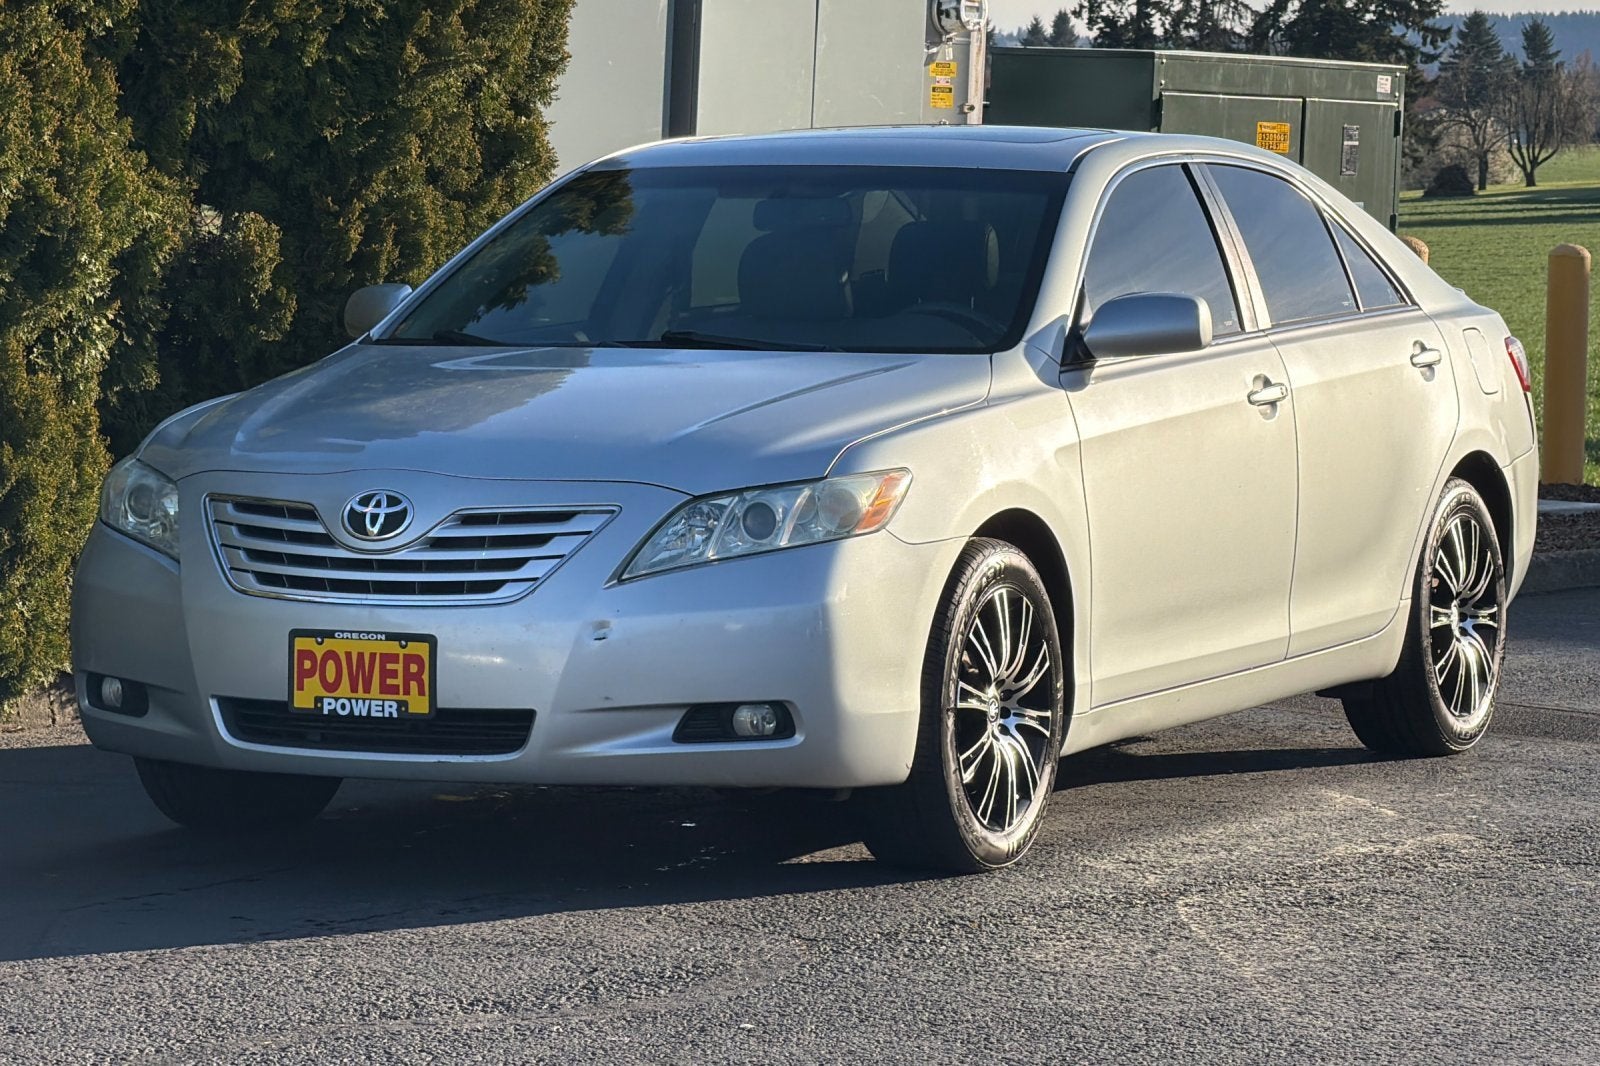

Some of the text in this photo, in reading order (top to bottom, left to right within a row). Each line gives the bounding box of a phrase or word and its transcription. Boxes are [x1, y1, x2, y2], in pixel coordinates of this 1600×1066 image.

[334, 631, 386, 641] OREGON
[296, 649, 426, 697] POWER
[323, 698, 398, 718] POWER
